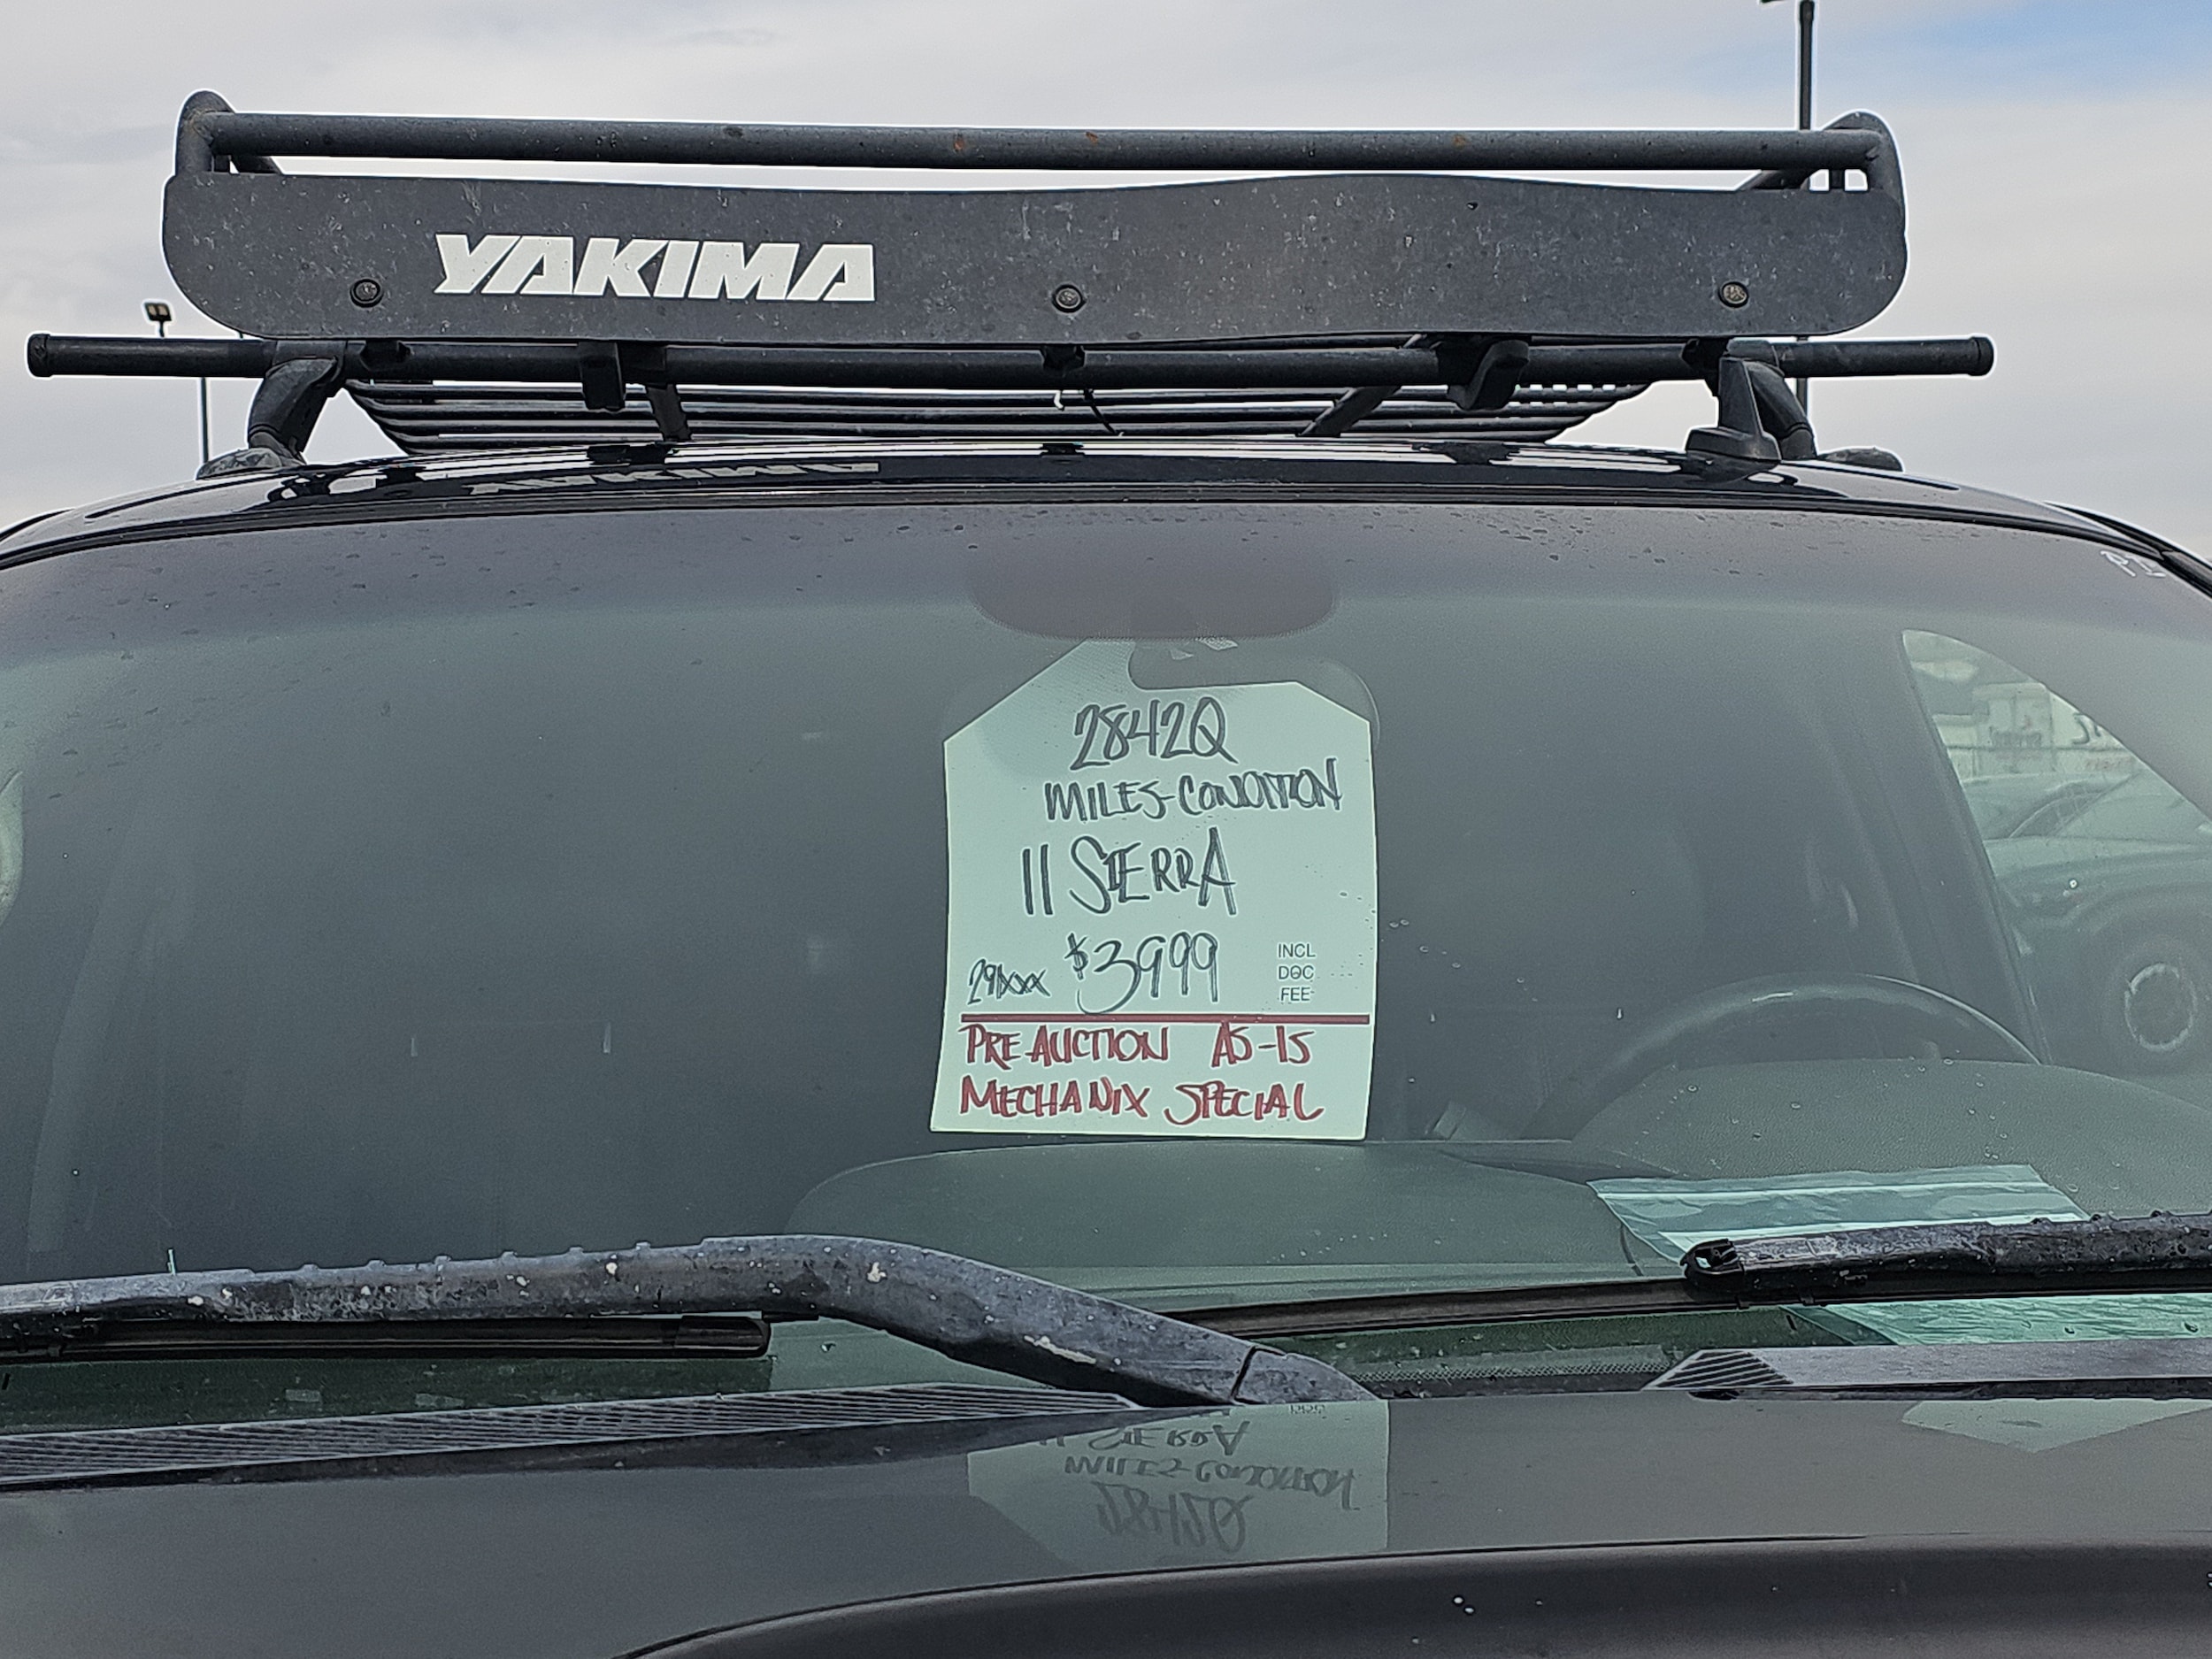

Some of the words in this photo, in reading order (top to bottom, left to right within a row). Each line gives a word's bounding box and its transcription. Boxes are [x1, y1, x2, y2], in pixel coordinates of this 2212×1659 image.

[434, 234, 875, 302] YAKIMA
[1070, 696, 1239, 770] 2842Q
[1069, 826, 1237, 915] SIERRA
[1064, 931, 1218, 1015] $3999
[1278, 943, 1316, 958] INCL
[1278, 964, 1314, 979] DOC
[1280, 987, 1311, 1002] FEE
[958, 1024, 1021, 1070] PRE
[1025, 1025, 1169, 1067] AUCTION
[1210, 1022, 1315, 1068] AS-IS
[959, 1075, 1150, 1118] MECHANIX
[1164, 1080, 1325, 1125] SPECIAL
